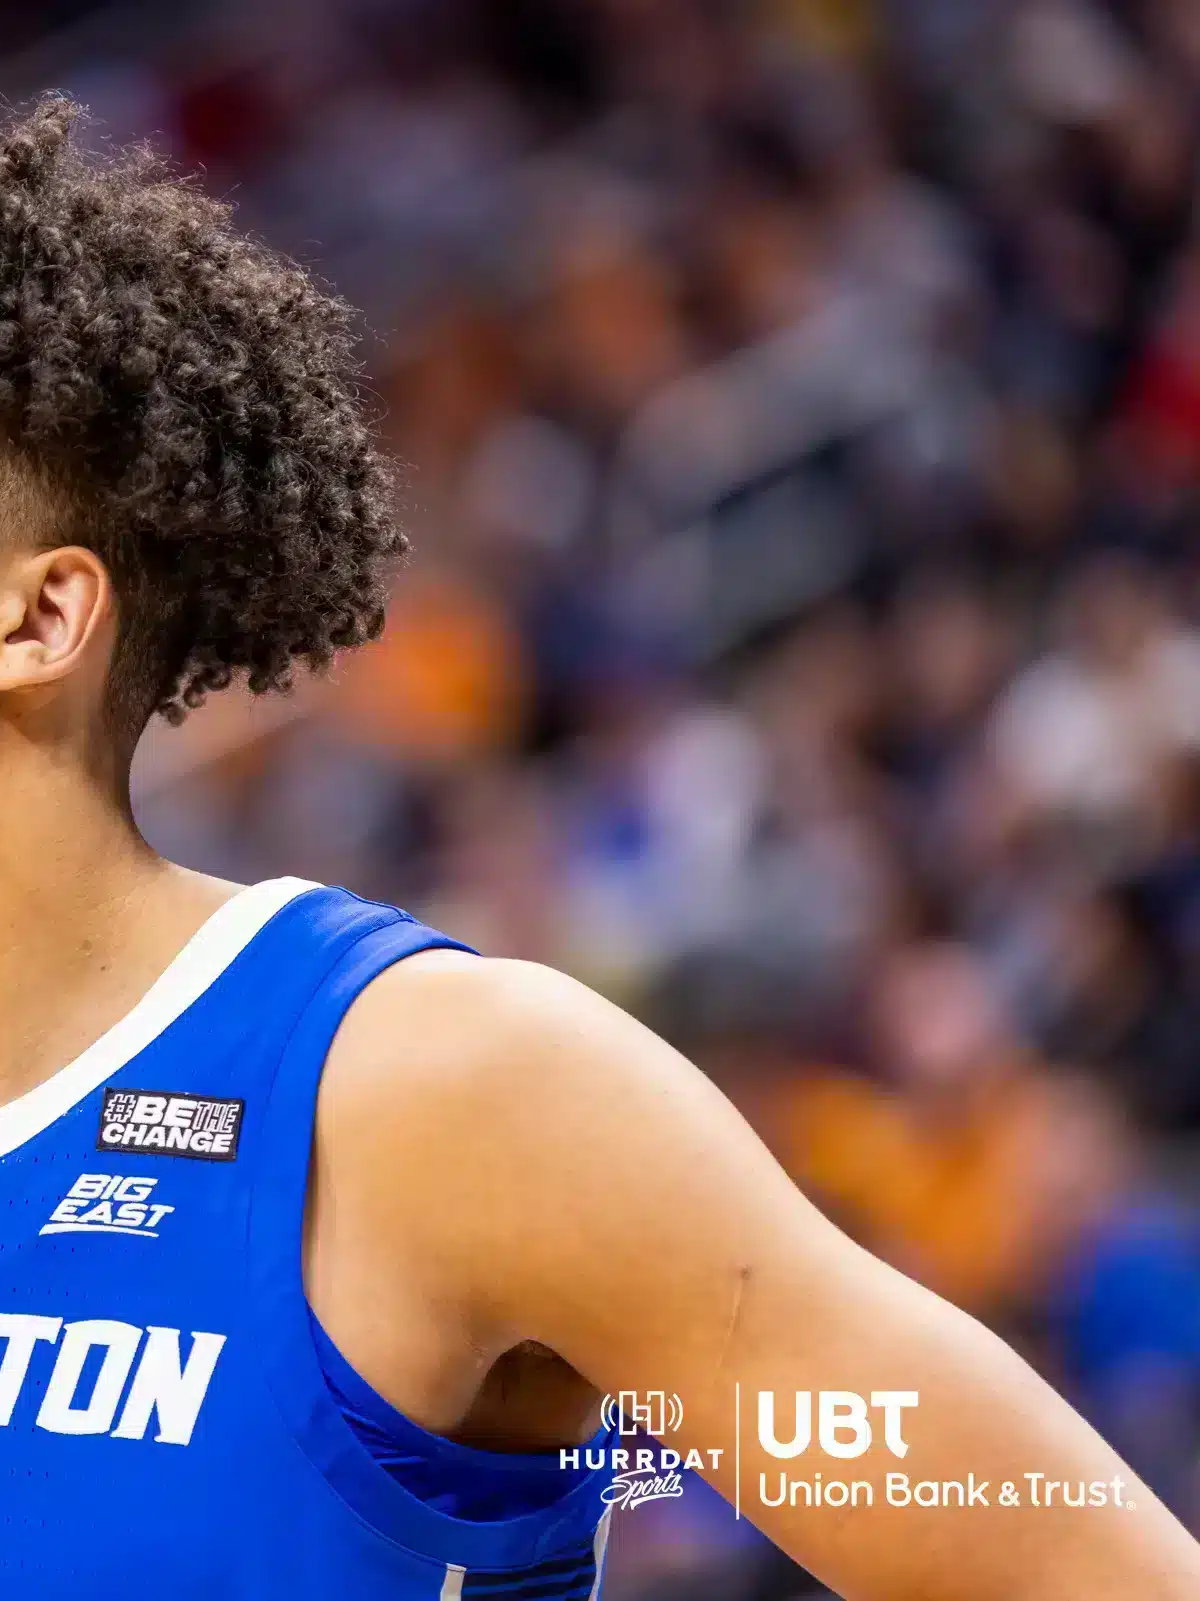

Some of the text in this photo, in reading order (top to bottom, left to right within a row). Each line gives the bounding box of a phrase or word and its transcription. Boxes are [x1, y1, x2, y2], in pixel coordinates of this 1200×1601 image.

[102, 1122, 234, 1153] CHANGE
[66, 1173, 159, 1202] BIG
[49, 1198, 176, 1228] EAST
